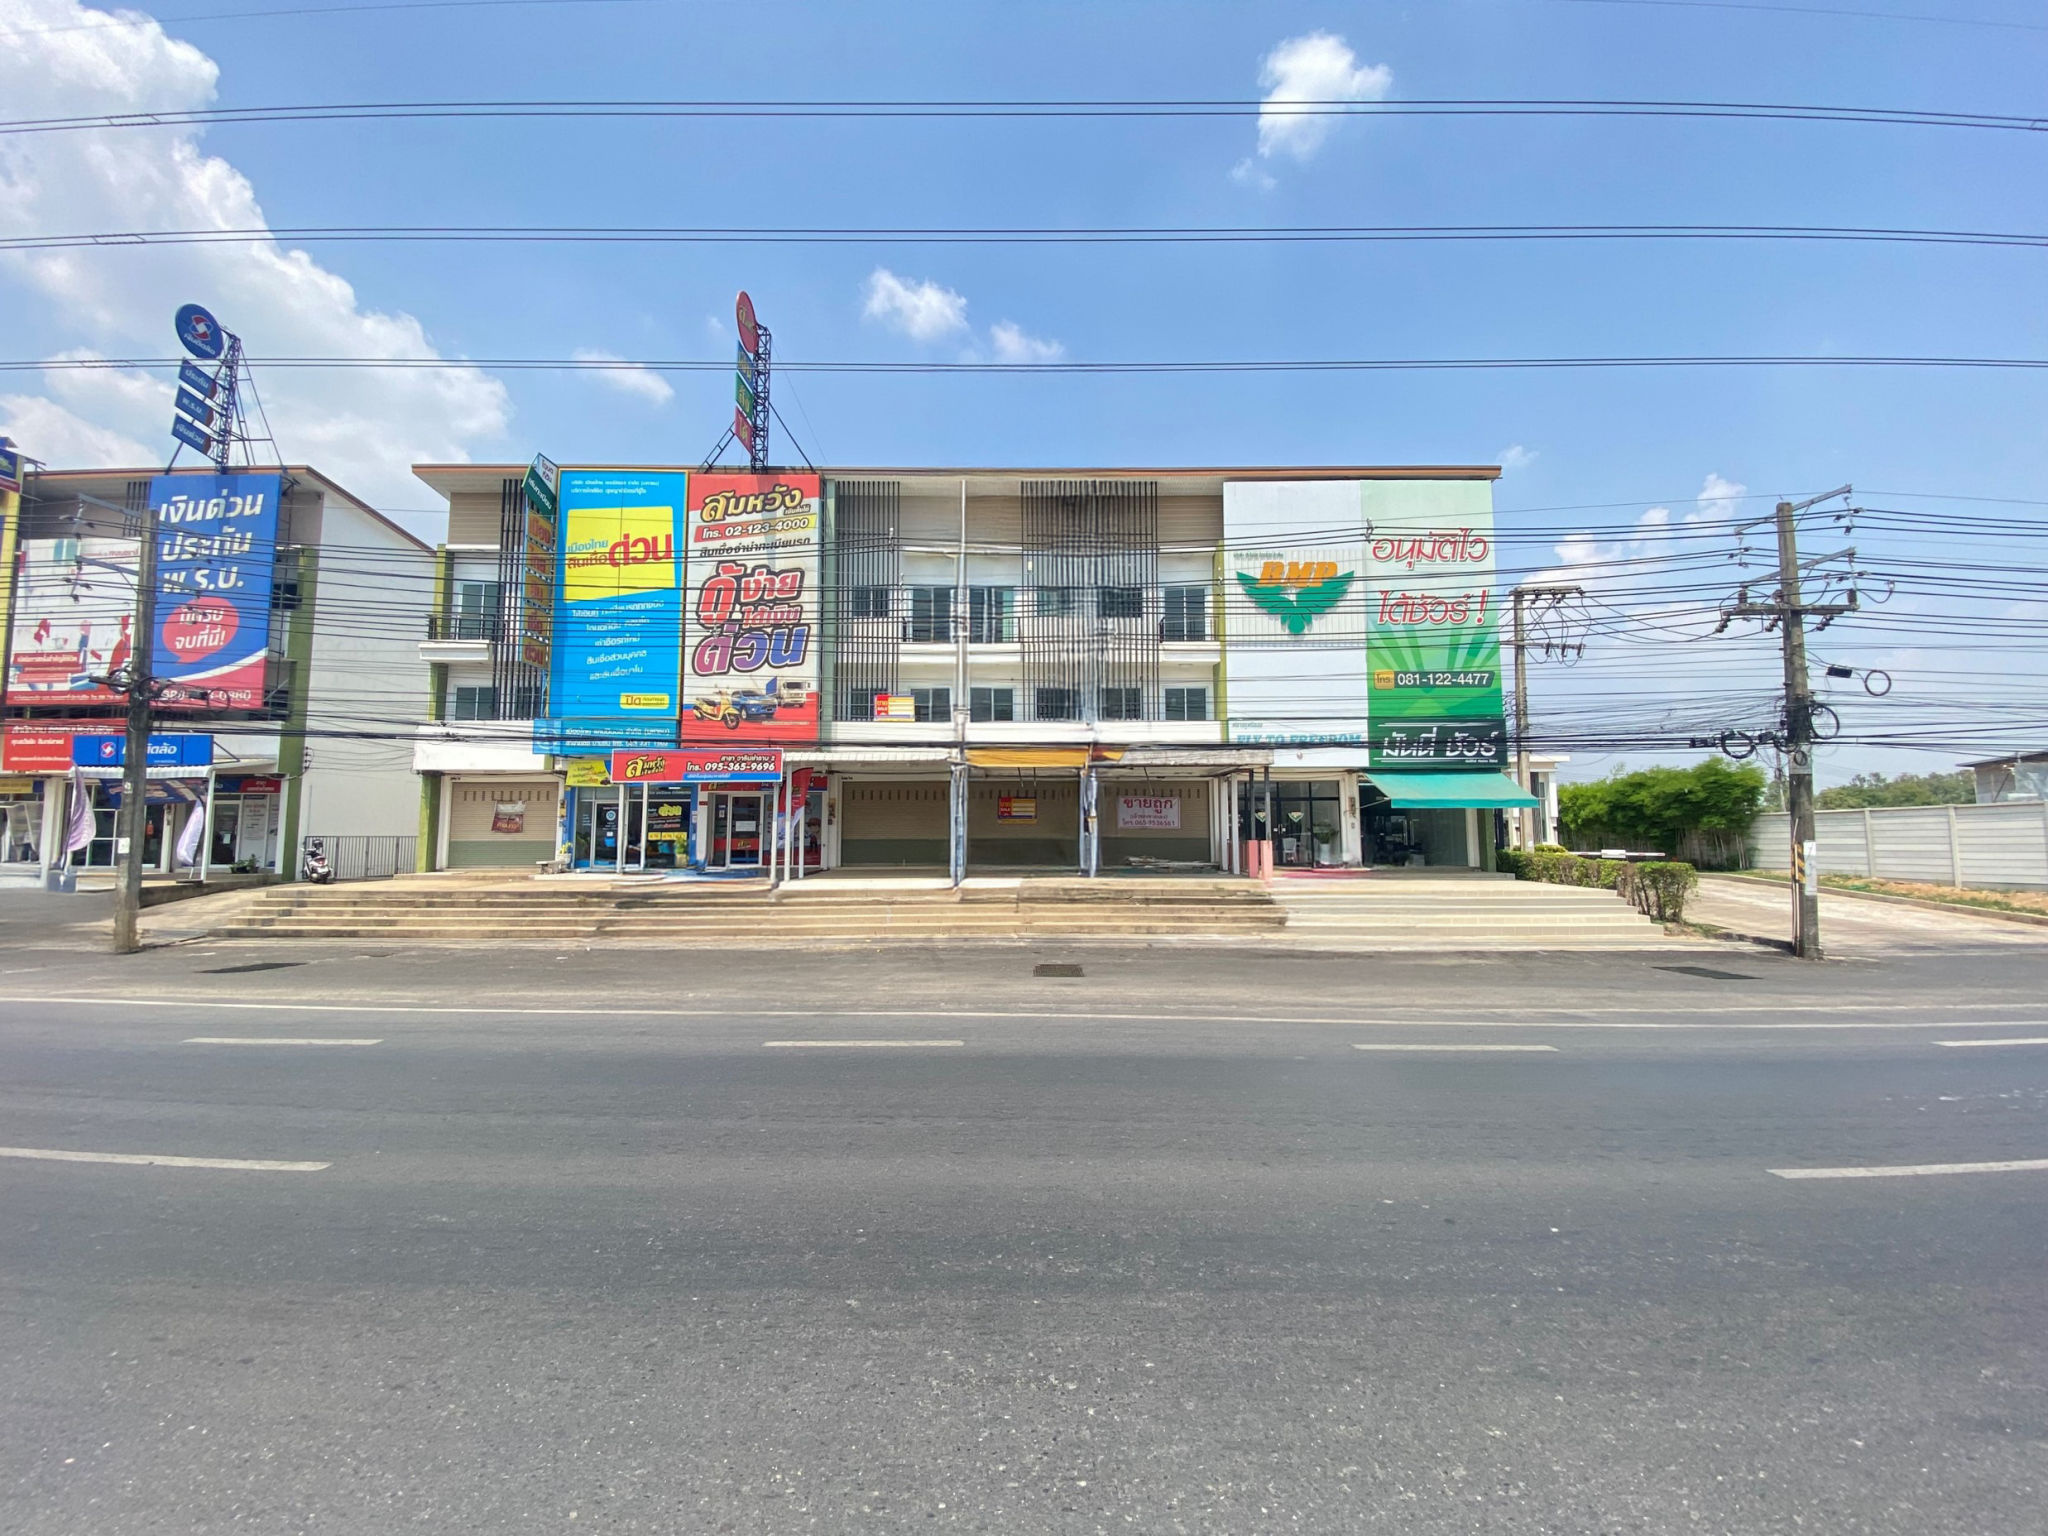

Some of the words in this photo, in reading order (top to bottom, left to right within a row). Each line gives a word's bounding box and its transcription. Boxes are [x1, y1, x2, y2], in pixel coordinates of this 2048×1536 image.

[159, 489, 264, 523] เงินด่วน
[701, 484, 803, 522] สมหวัง
[702, 527, 722, 539] โทร.
[725, 518, 809, 536] 02-123-4000
[162, 526, 252, 561] ประกัน
[567, 538, 609, 553] เมืองไทย
[608, 533, 672, 568] ด่วน
[1372, 527, 1489, 570] อนุมัติไว
[163, 566, 244, 595] พ.ร.บ.
[175, 624, 226, 649] จบที่นี่!
[695, 622, 809, 674] ด่วน
[1397, 673, 1490, 685] 081-122-4477
[705, 762, 775, 771] 095-365-9696
[1123, 798, 1173, 814] ขายถูก
